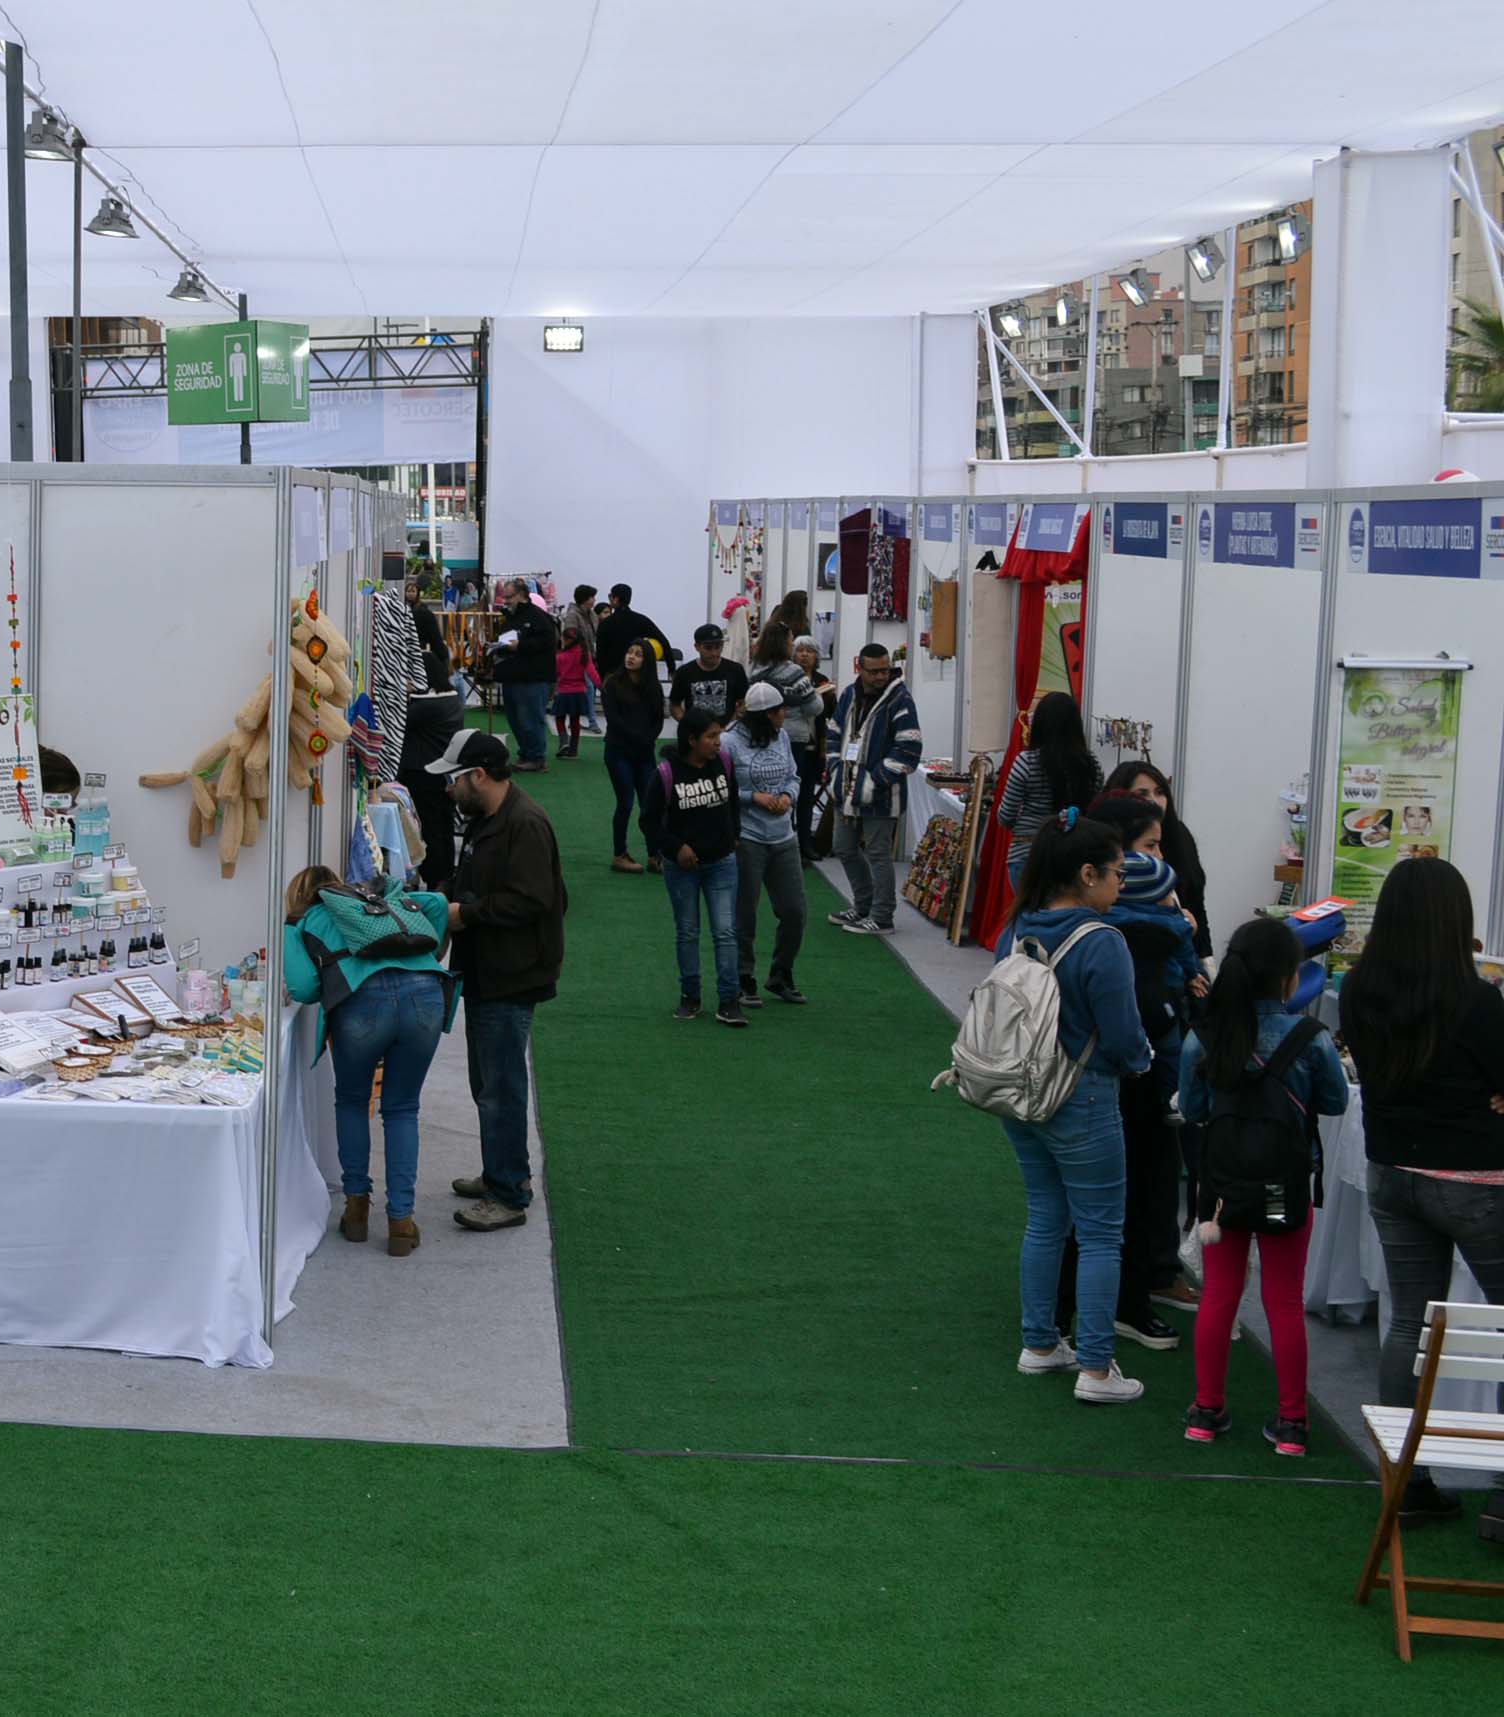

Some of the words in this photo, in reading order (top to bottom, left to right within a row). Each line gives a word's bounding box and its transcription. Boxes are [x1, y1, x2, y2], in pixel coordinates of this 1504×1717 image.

[176, 363, 200, 378] ZONA
[202, 361, 213, 375] DE
[174, 375, 222, 391] SEGURIDAD
